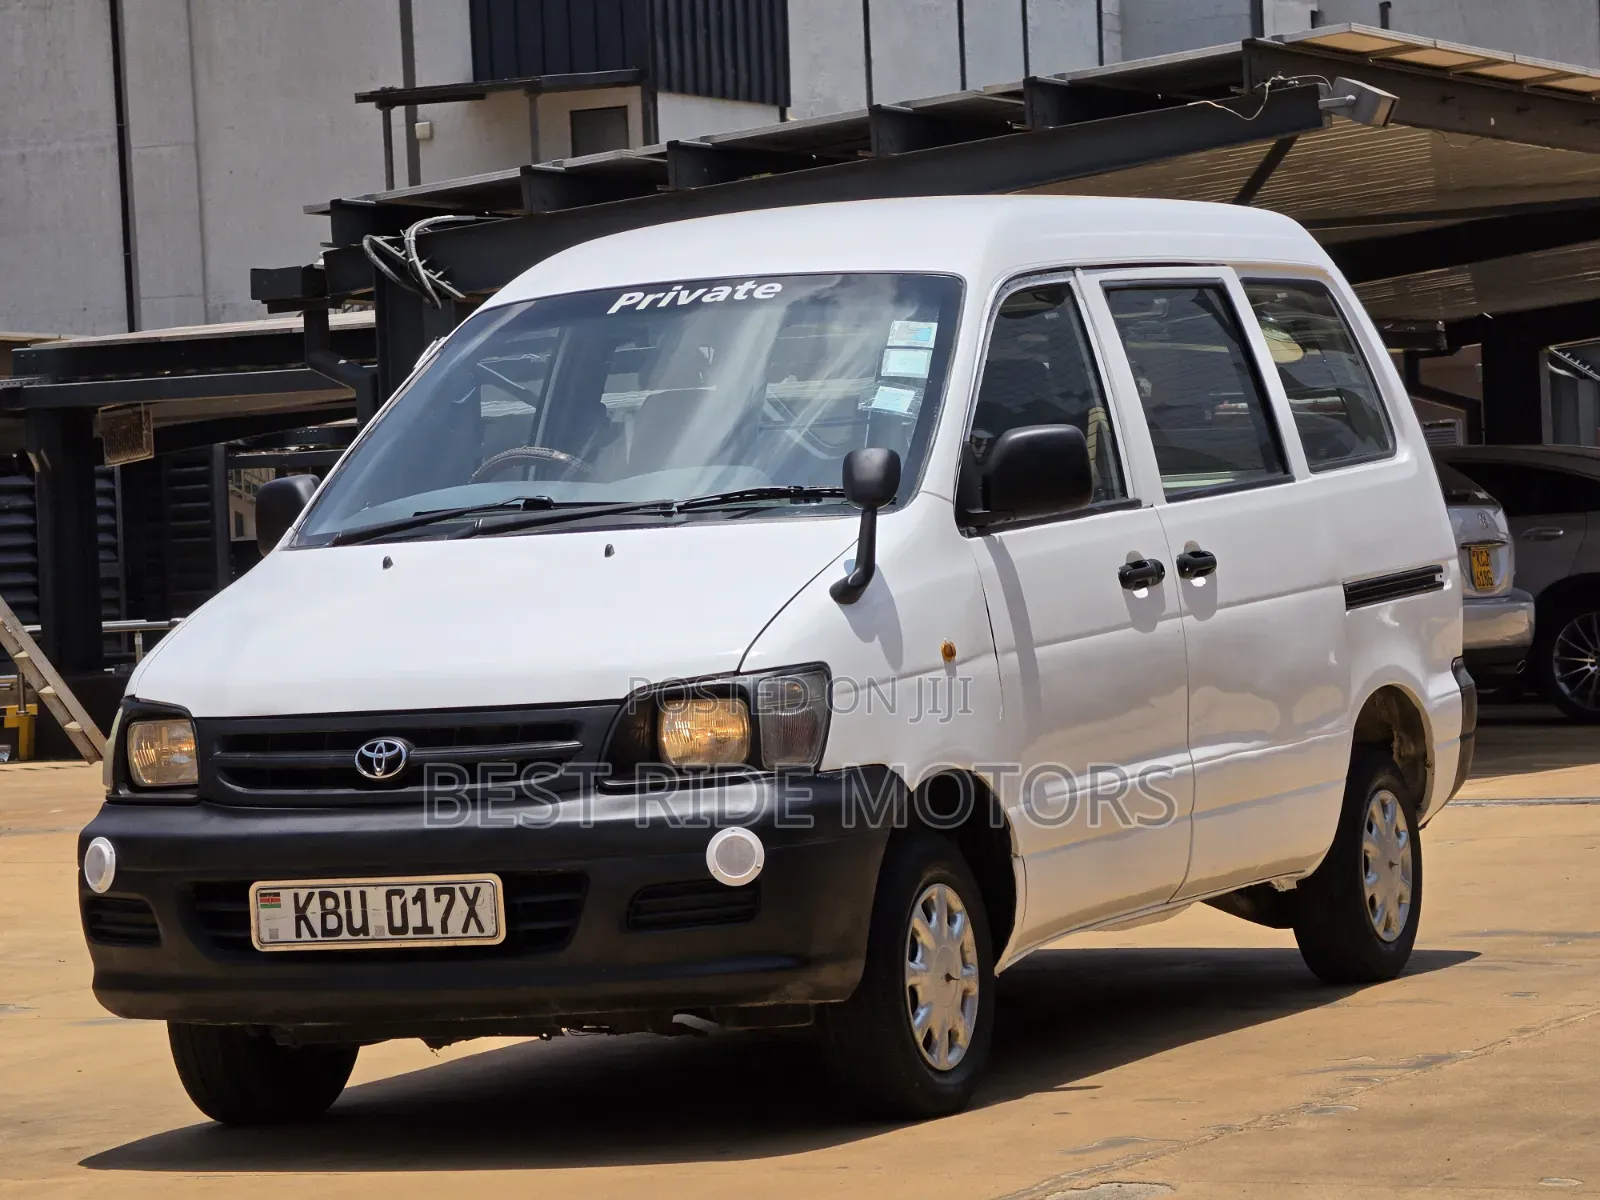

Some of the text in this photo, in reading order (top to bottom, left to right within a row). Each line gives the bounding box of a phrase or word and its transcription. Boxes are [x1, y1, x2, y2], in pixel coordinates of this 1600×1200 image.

[606, 280, 783, 315] Private
[293, 889, 370, 939] KBU
[385, 887, 485, 936] 017X
